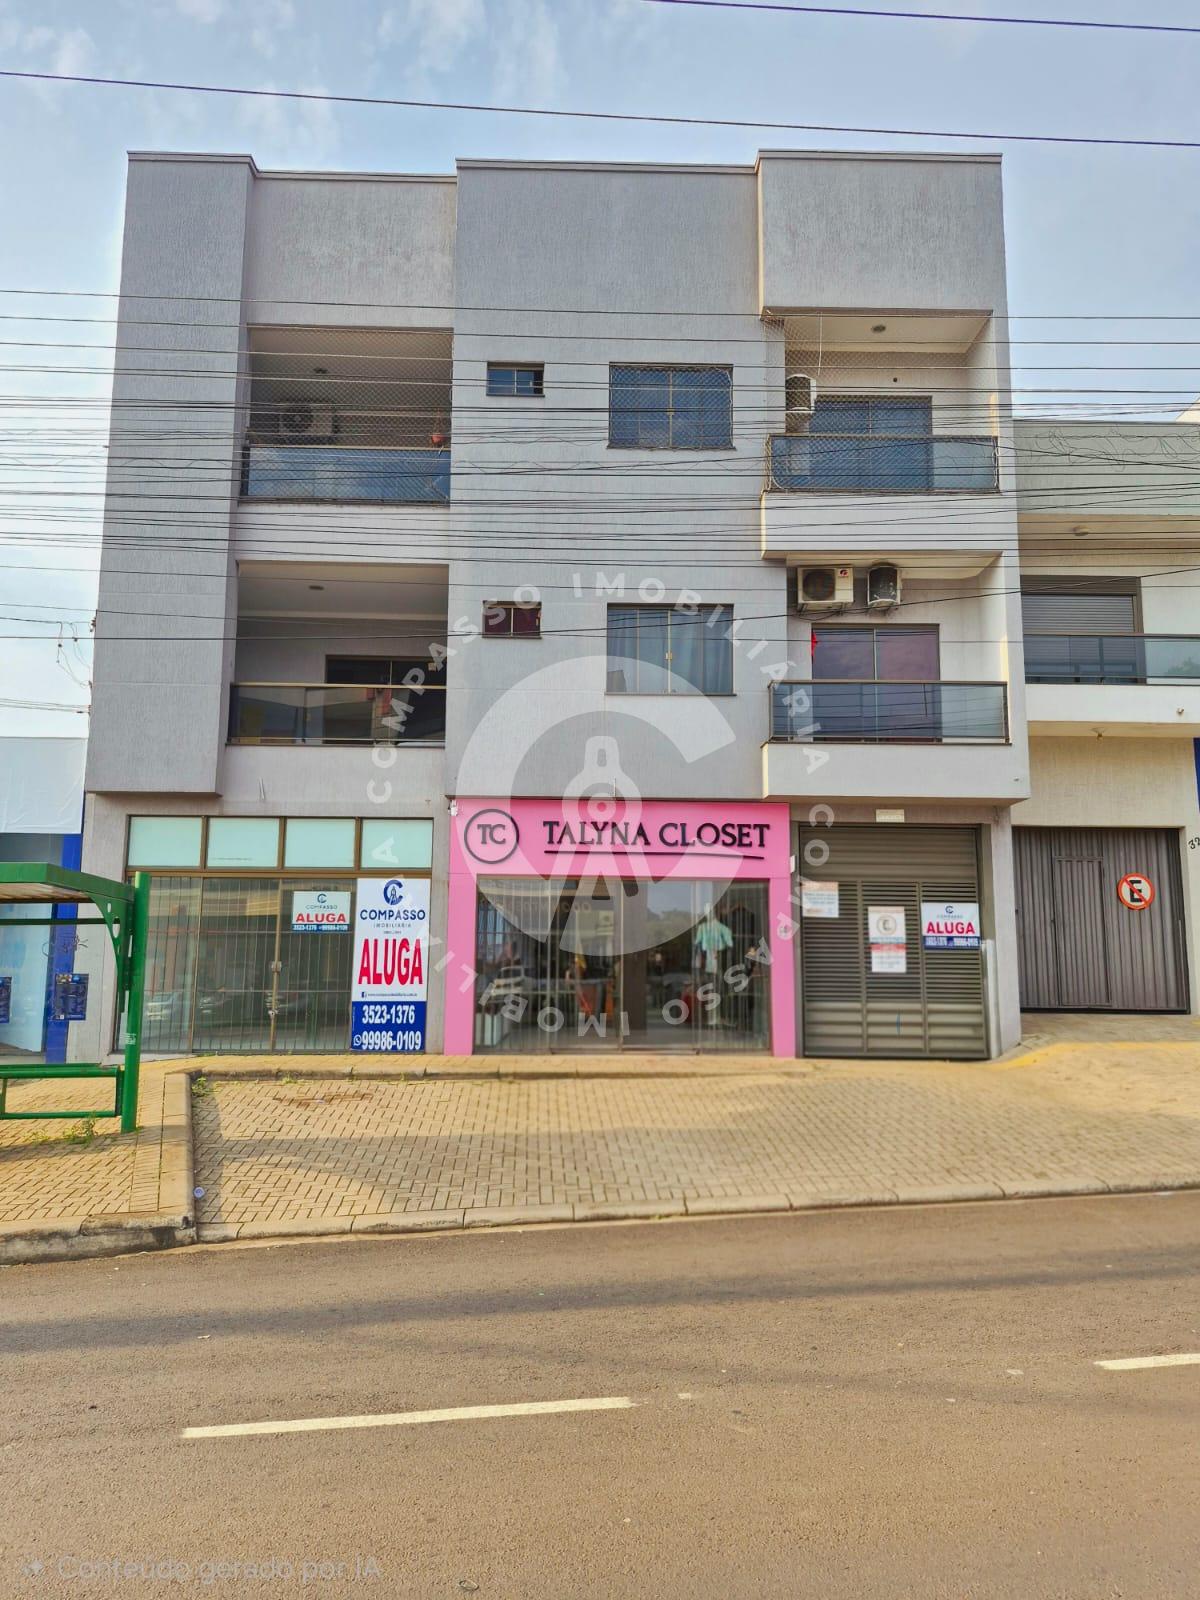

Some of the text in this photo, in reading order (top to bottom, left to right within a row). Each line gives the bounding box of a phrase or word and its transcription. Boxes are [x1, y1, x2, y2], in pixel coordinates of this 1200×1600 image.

[477, 823, 507, 845] TC
[543, 821, 770, 848] TALYNA CLOSET
[1129, 880, 1143, 902] E
[296, 913, 346, 923] ALUGA
[360, 909, 426, 920] COMPASSO
[927, 921, 975, 934] ALUGA
[358, 938, 423, 985] ALUGA
[362, 1005, 415, 1024] 3523-1376
[362, 1030, 422, 1050] 99986-0109
